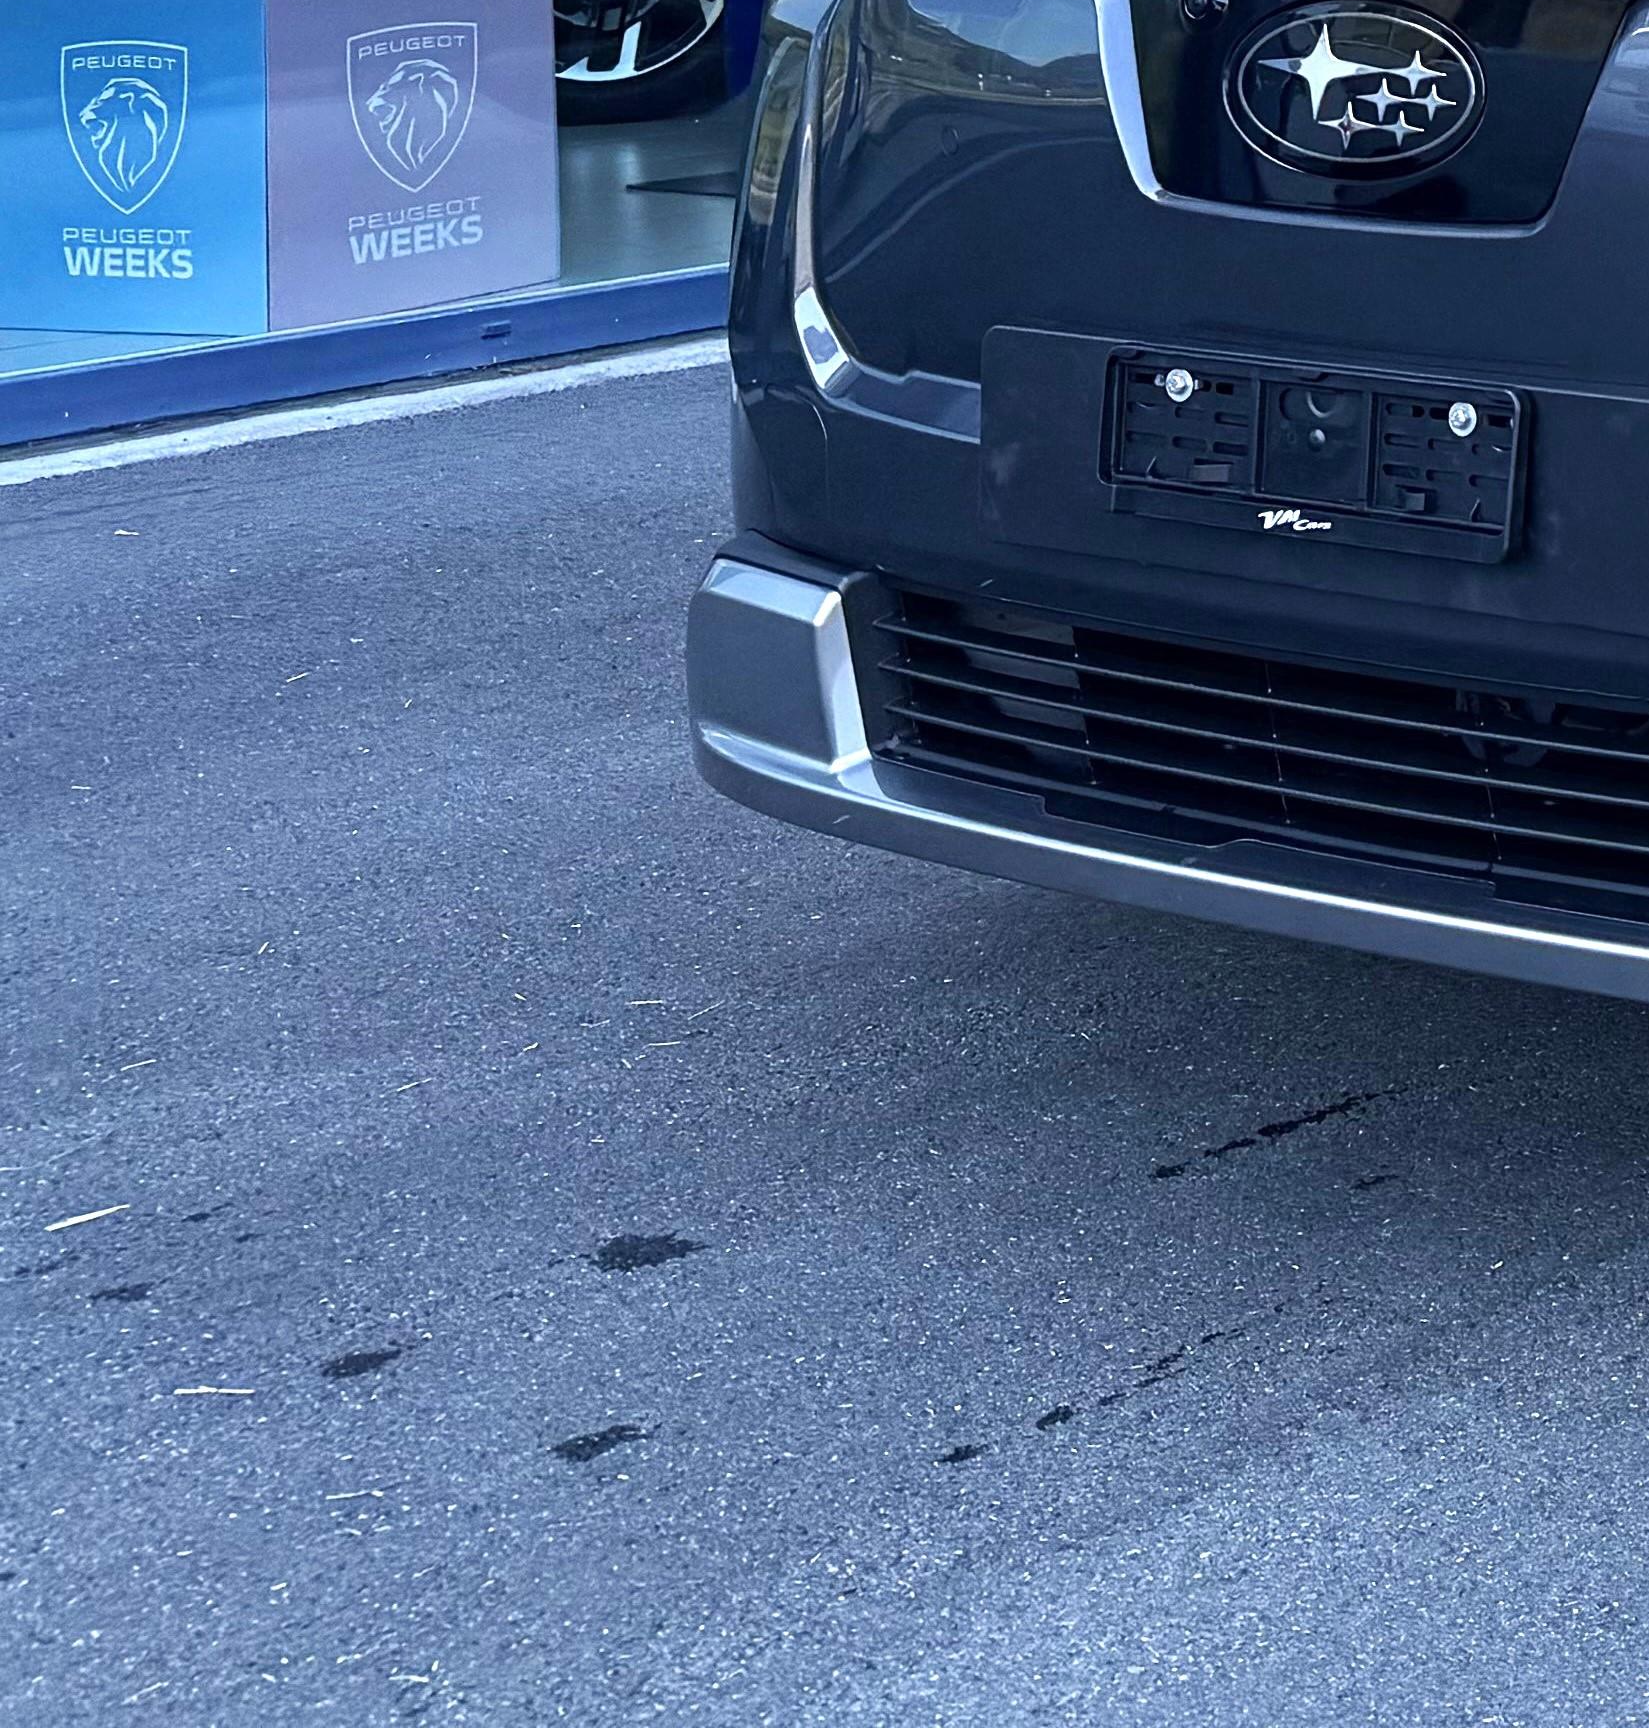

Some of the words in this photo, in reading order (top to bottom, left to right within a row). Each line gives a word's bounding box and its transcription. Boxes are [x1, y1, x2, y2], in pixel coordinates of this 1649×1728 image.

[358, 34, 466, 60] PEUGEOT
[71, 54, 177, 71] PEUGEOT
[348, 196, 482, 233] PEUGEOT
[62, 227, 193, 246] PEUGEOT
[349, 214, 484, 265] WEEKS
[63, 246, 194, 280] WEEKS
